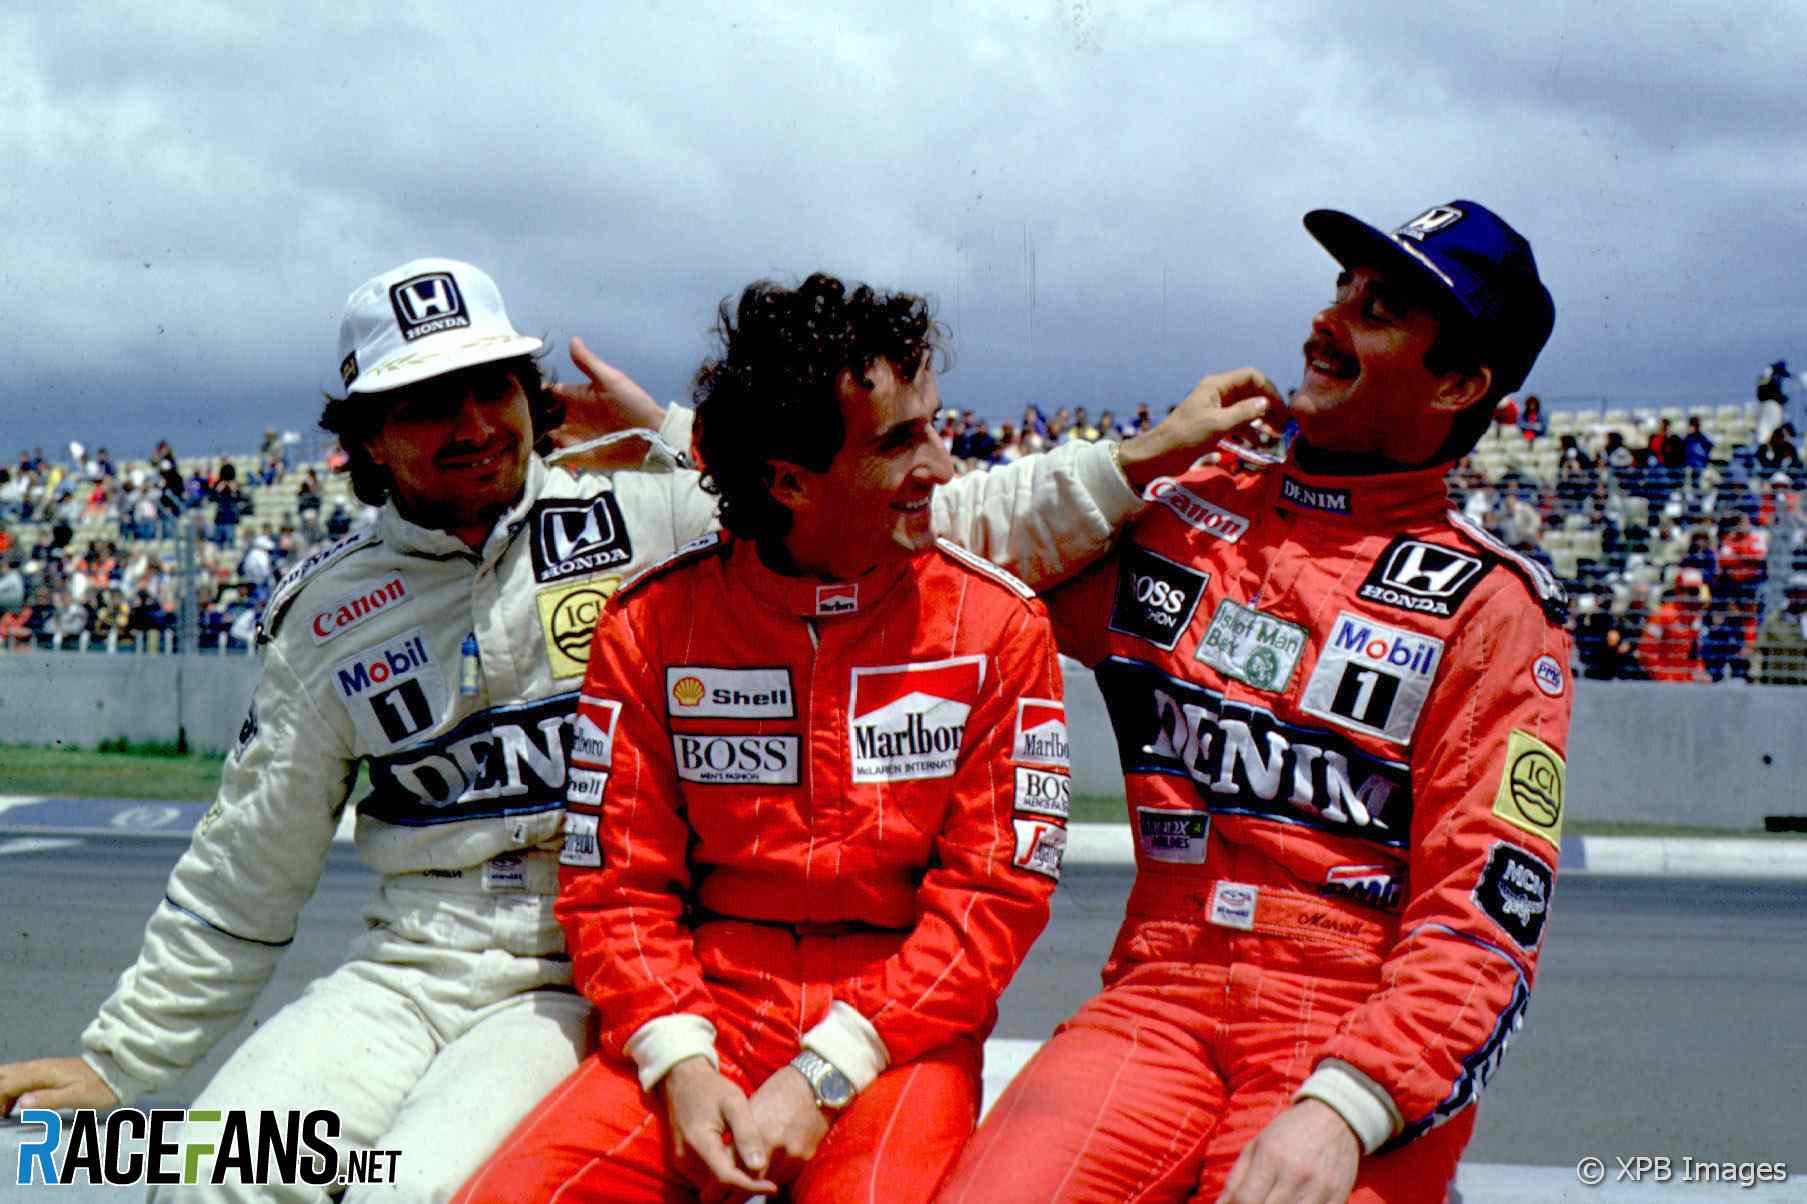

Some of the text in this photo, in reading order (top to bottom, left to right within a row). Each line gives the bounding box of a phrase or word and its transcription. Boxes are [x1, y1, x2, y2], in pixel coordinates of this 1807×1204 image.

[405, 317, 468, 340] HONDA
[1151, 483, 1241, 537] Canon
[1284, 480, 1347, 510] DENIM
[541, 548, 630, 581] HONDA
[313, 578, 406, 638] Canon
[1131, 573, 1186, 613] OSS
[1360, 584, 1450, 615] HONDA
[566, 600, 602, 628] ICI
[1257, 623, 1299, 654] Man
[1335, 620, 1436, 675] Mobil
[337, 636, 428, 697] Mobil
[385, 688, 418, 734] 1
[712, 688, 788, 705] Shell
[1351, 670, 1380, 721] 1
[854, 712, 965, 760] Marlbor
[1023, 732, 1070, 758] Marlbo
[390, 713, 576, 809] DEN
[680, 738, 788, 772] BOSS
[905, 760, 957, 773] INTERNAT
[1142, 689, 1394, 829] DENIM
[1026, 773, 1070, 801] BOS
[1528, 760, 1554, 793] ICI
